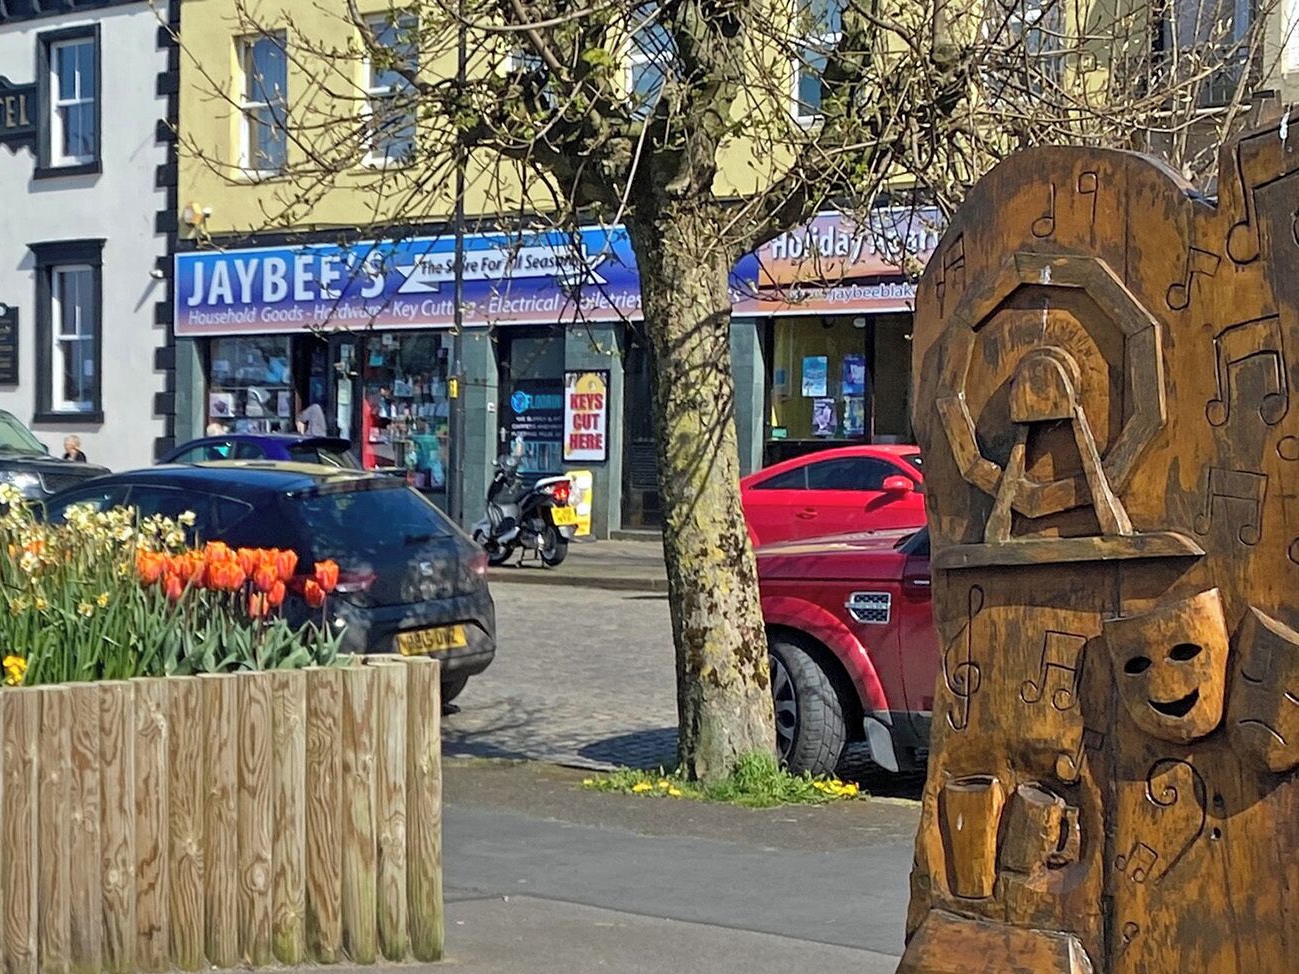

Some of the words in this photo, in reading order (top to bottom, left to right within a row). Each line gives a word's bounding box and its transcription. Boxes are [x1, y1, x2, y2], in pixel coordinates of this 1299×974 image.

[772, 225, 864, 263] Holiday
[445, 258, 478, 273] Sre
[481, 256, 502, 271] For
[187, 250, 385, 307] JAYBEE'S
[188, 307, 256, 325] Household
[261, 304, 303, 323] Goods
[392, 301, 418, 320] Key
[489, 293, 560, 313] Electrical
[571, 290, 642, 310] oiletries
[569, 393, 603, 411] KEYS
[572, 413, 600, 430] CUT
[569, 433, 603, 450] HERE
